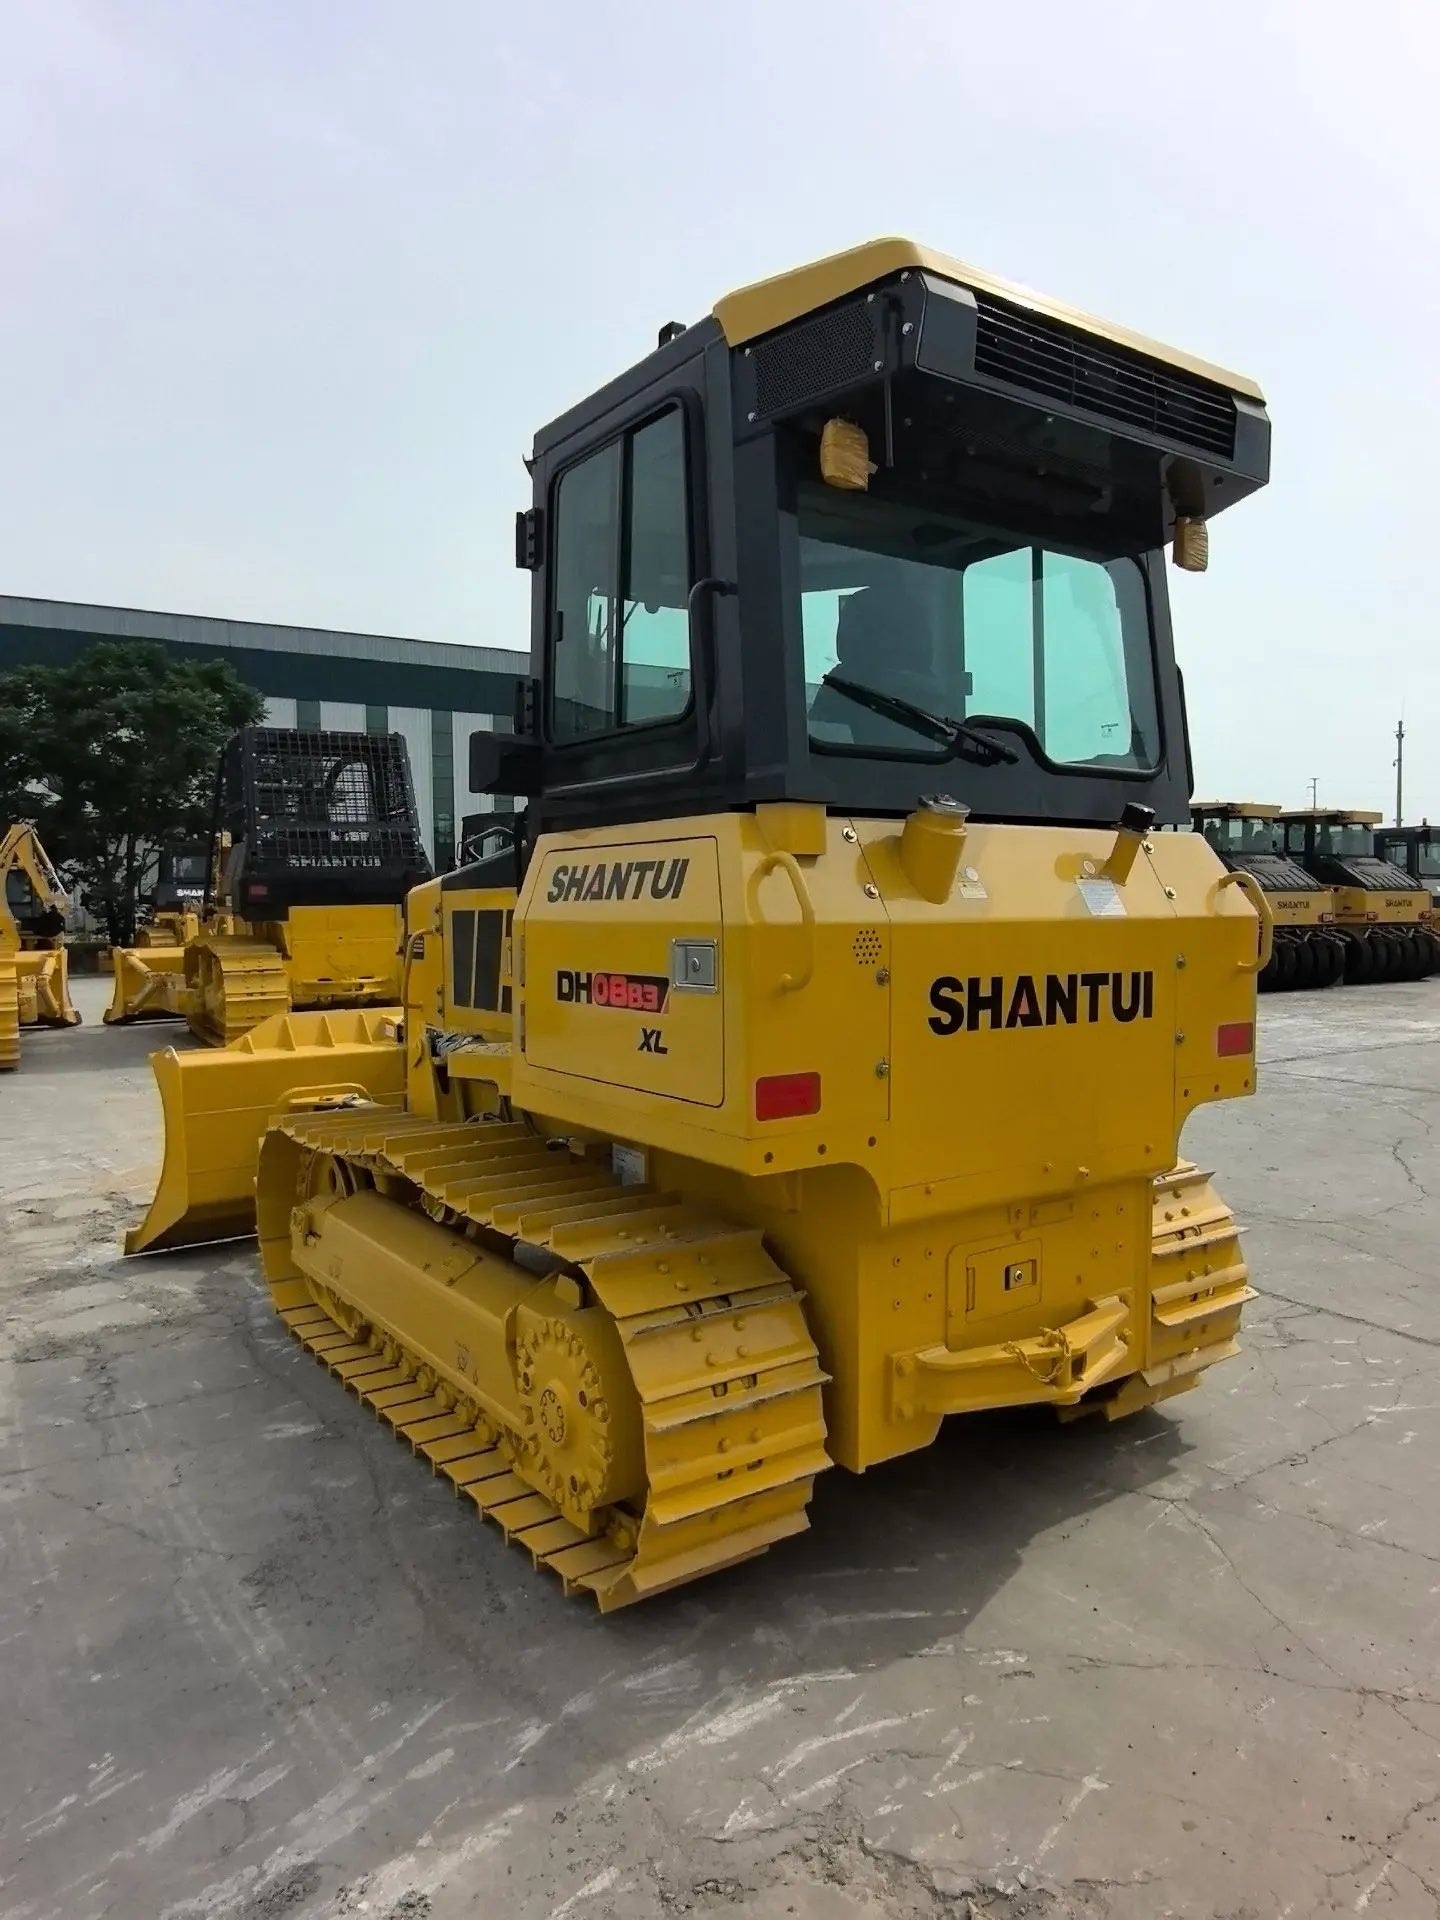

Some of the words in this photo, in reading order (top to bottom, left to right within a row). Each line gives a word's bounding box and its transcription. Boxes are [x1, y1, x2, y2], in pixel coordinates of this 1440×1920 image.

[176, 889, 205, 897] SHAN
[547, 858, 690, 903] SHANTUI
[1277, 901, 1310, 909] SHANTUI
[928, 971, 1154, 1036] SHANTUI
[637, 1027, 669, 1055] XL
